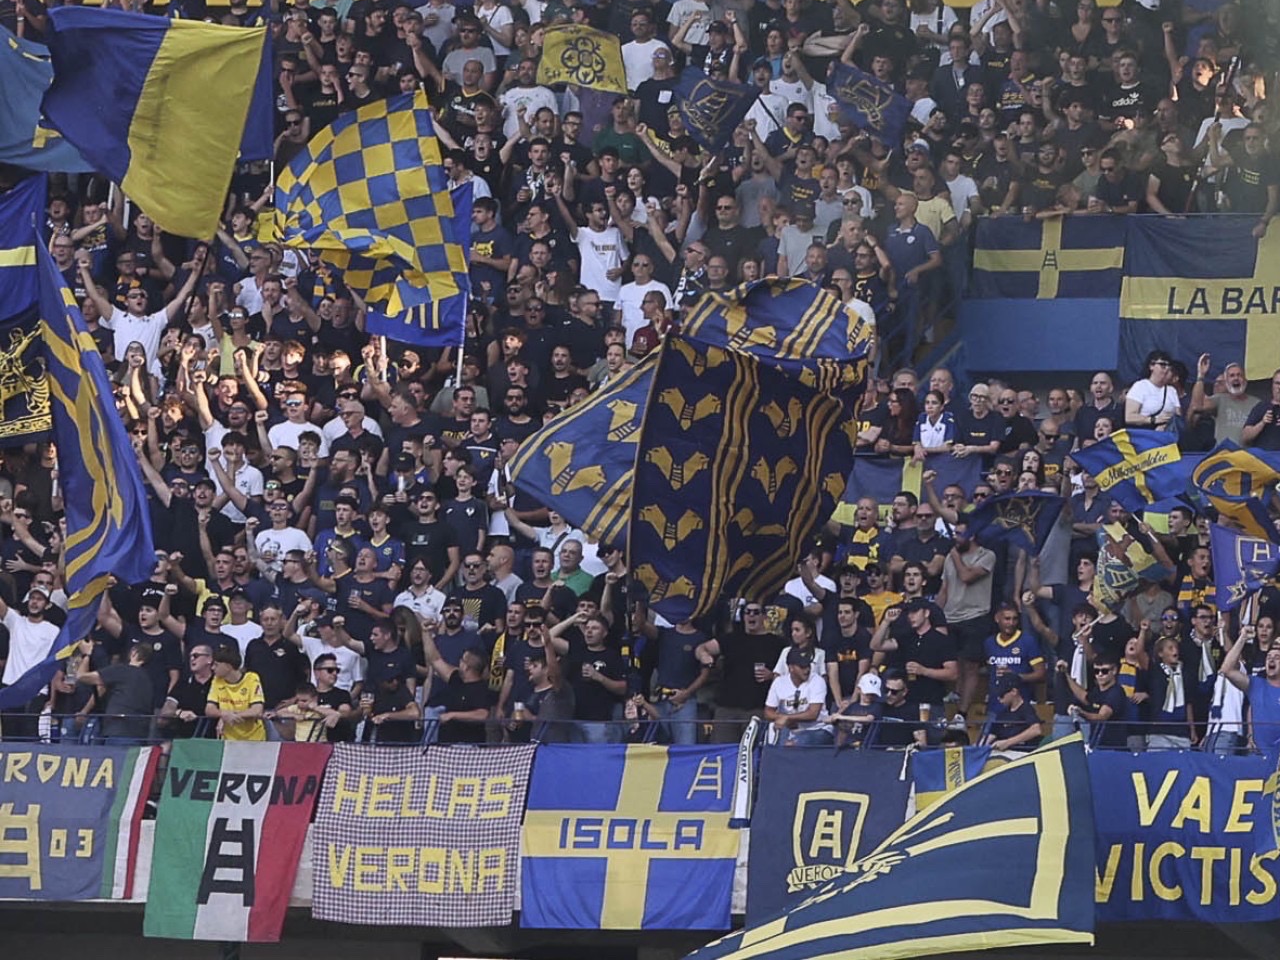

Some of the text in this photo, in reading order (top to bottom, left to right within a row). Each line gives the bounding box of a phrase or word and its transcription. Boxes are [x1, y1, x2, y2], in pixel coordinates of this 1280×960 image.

[1167, 286, 1211, 315] LA
[0, 752, 114, 789] RONA
[170, 767, 318, 806] VERONA
[332, 771, 515, 818] HELLAS
[1131, 769, 1264, 833] VAE
[559, 817, 704, 850] ISOLA
[328, 843, 507, 894] VERONA
[1094, 841, 1280, 906] VICTIS
